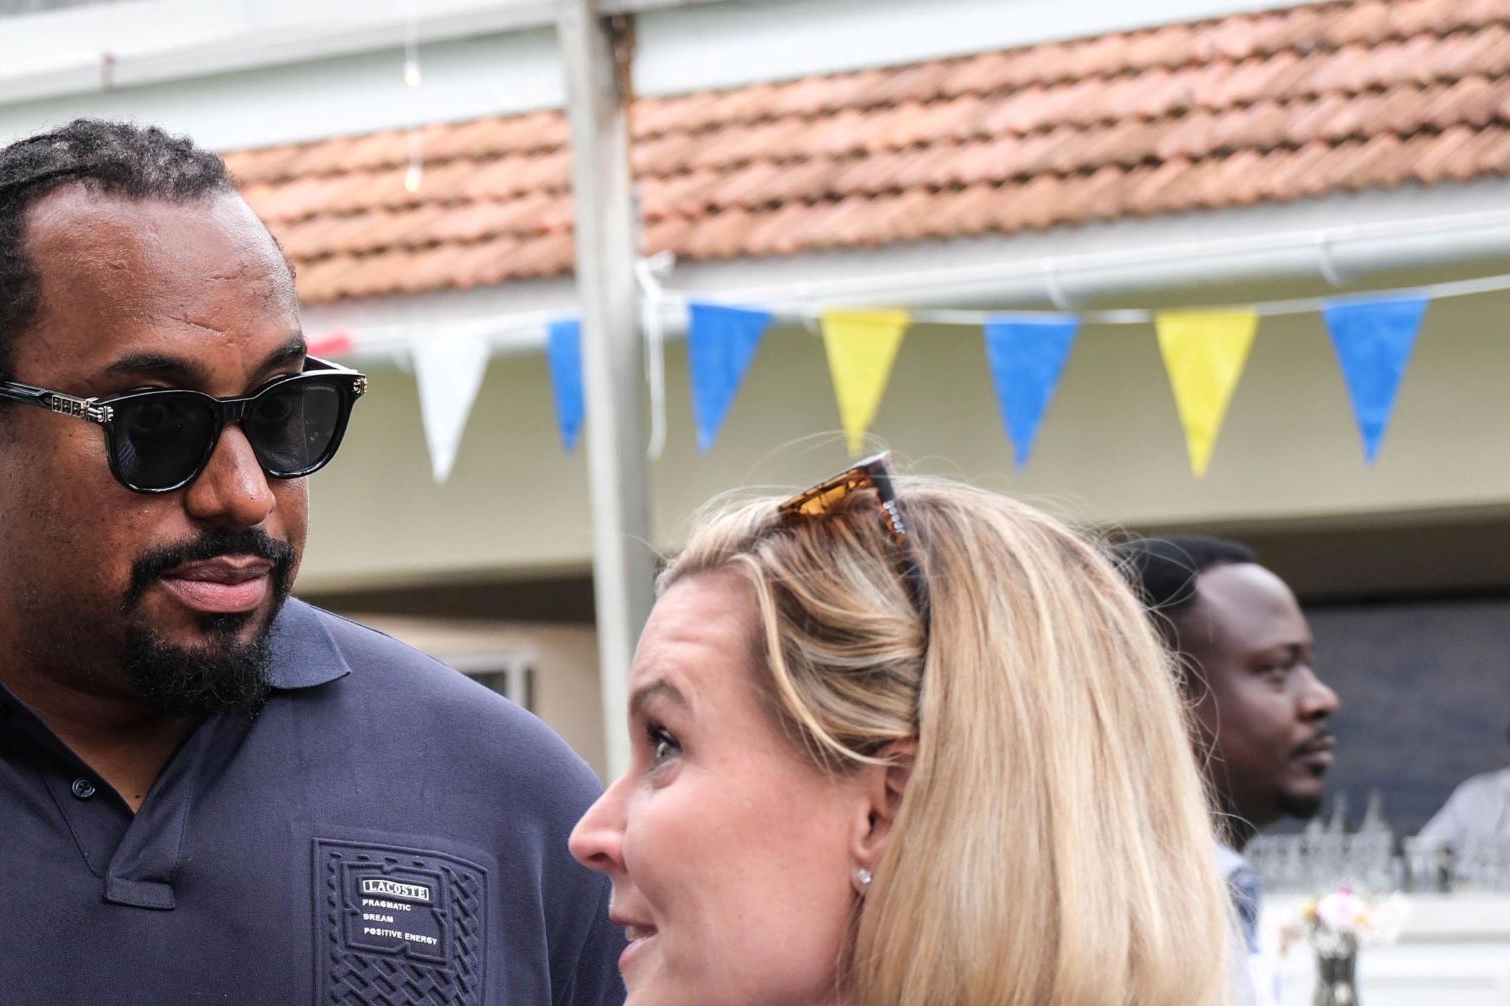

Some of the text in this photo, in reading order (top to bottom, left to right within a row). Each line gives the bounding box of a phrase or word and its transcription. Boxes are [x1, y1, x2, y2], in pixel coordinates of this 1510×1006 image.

[368, 881, 426, 898] LACOSTE
[362, 899, 411, 911] PRAGMATIC
[363, 927, 437, 945] POSITIVE ENERGY
